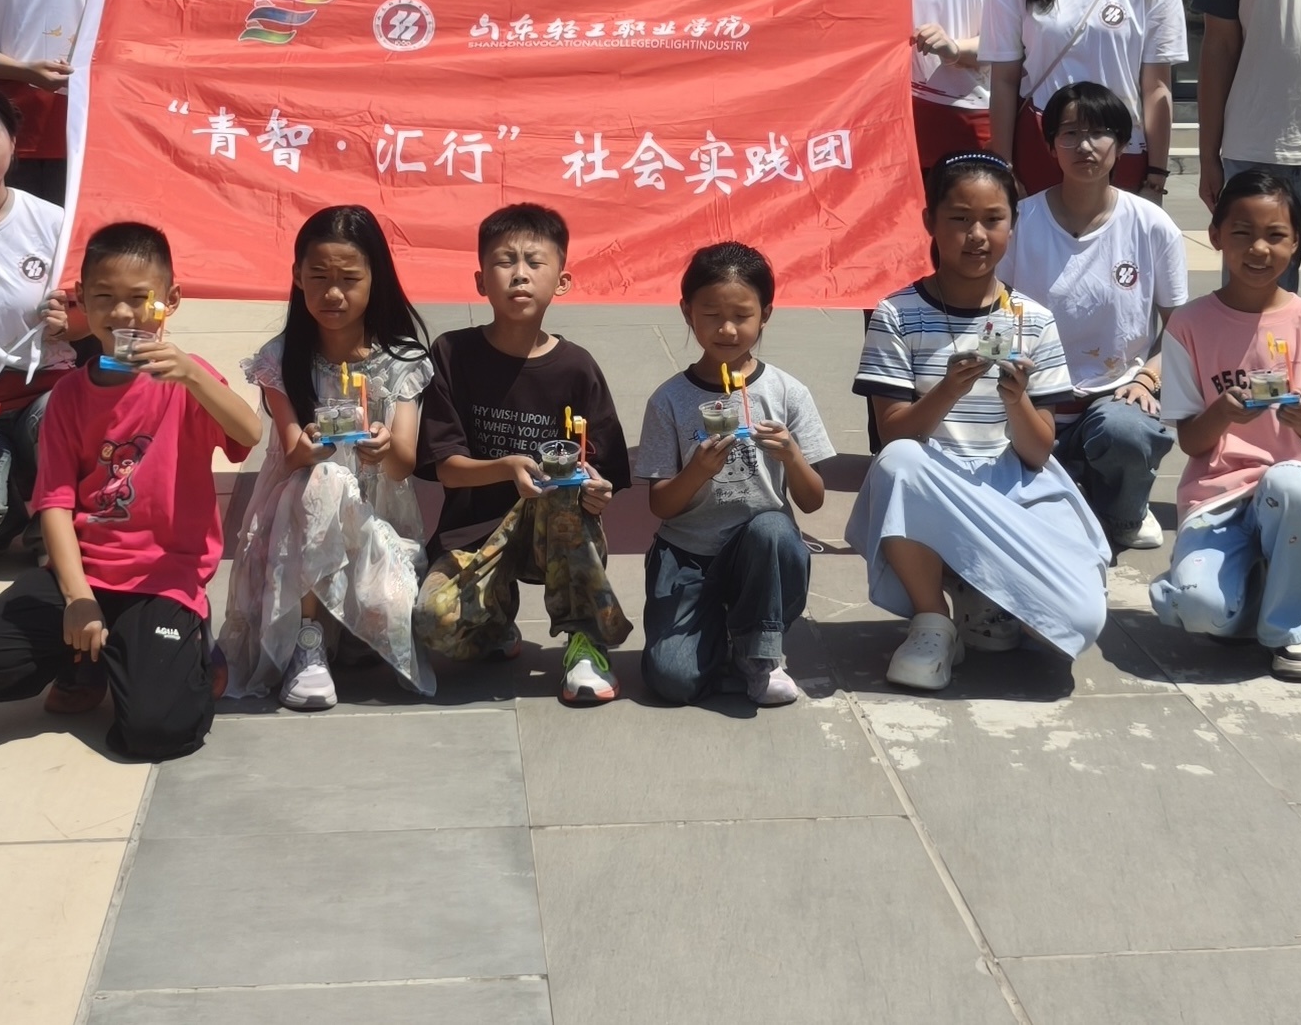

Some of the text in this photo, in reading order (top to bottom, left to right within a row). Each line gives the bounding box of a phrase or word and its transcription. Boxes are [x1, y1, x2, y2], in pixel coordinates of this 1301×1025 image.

[469, 13, 751, 41] 山东轻工职业学院
[561, 130, 853, 195] 社会实践团
[491, 407, 519, 422] WISH
[520, 412, 551, 426] UPON
[483, 420, 516, 435] WHEN
[517, 425, 541, 439] YOU
[492, 434, 507, 446] TO
[508, 437, 528, 450] THE
